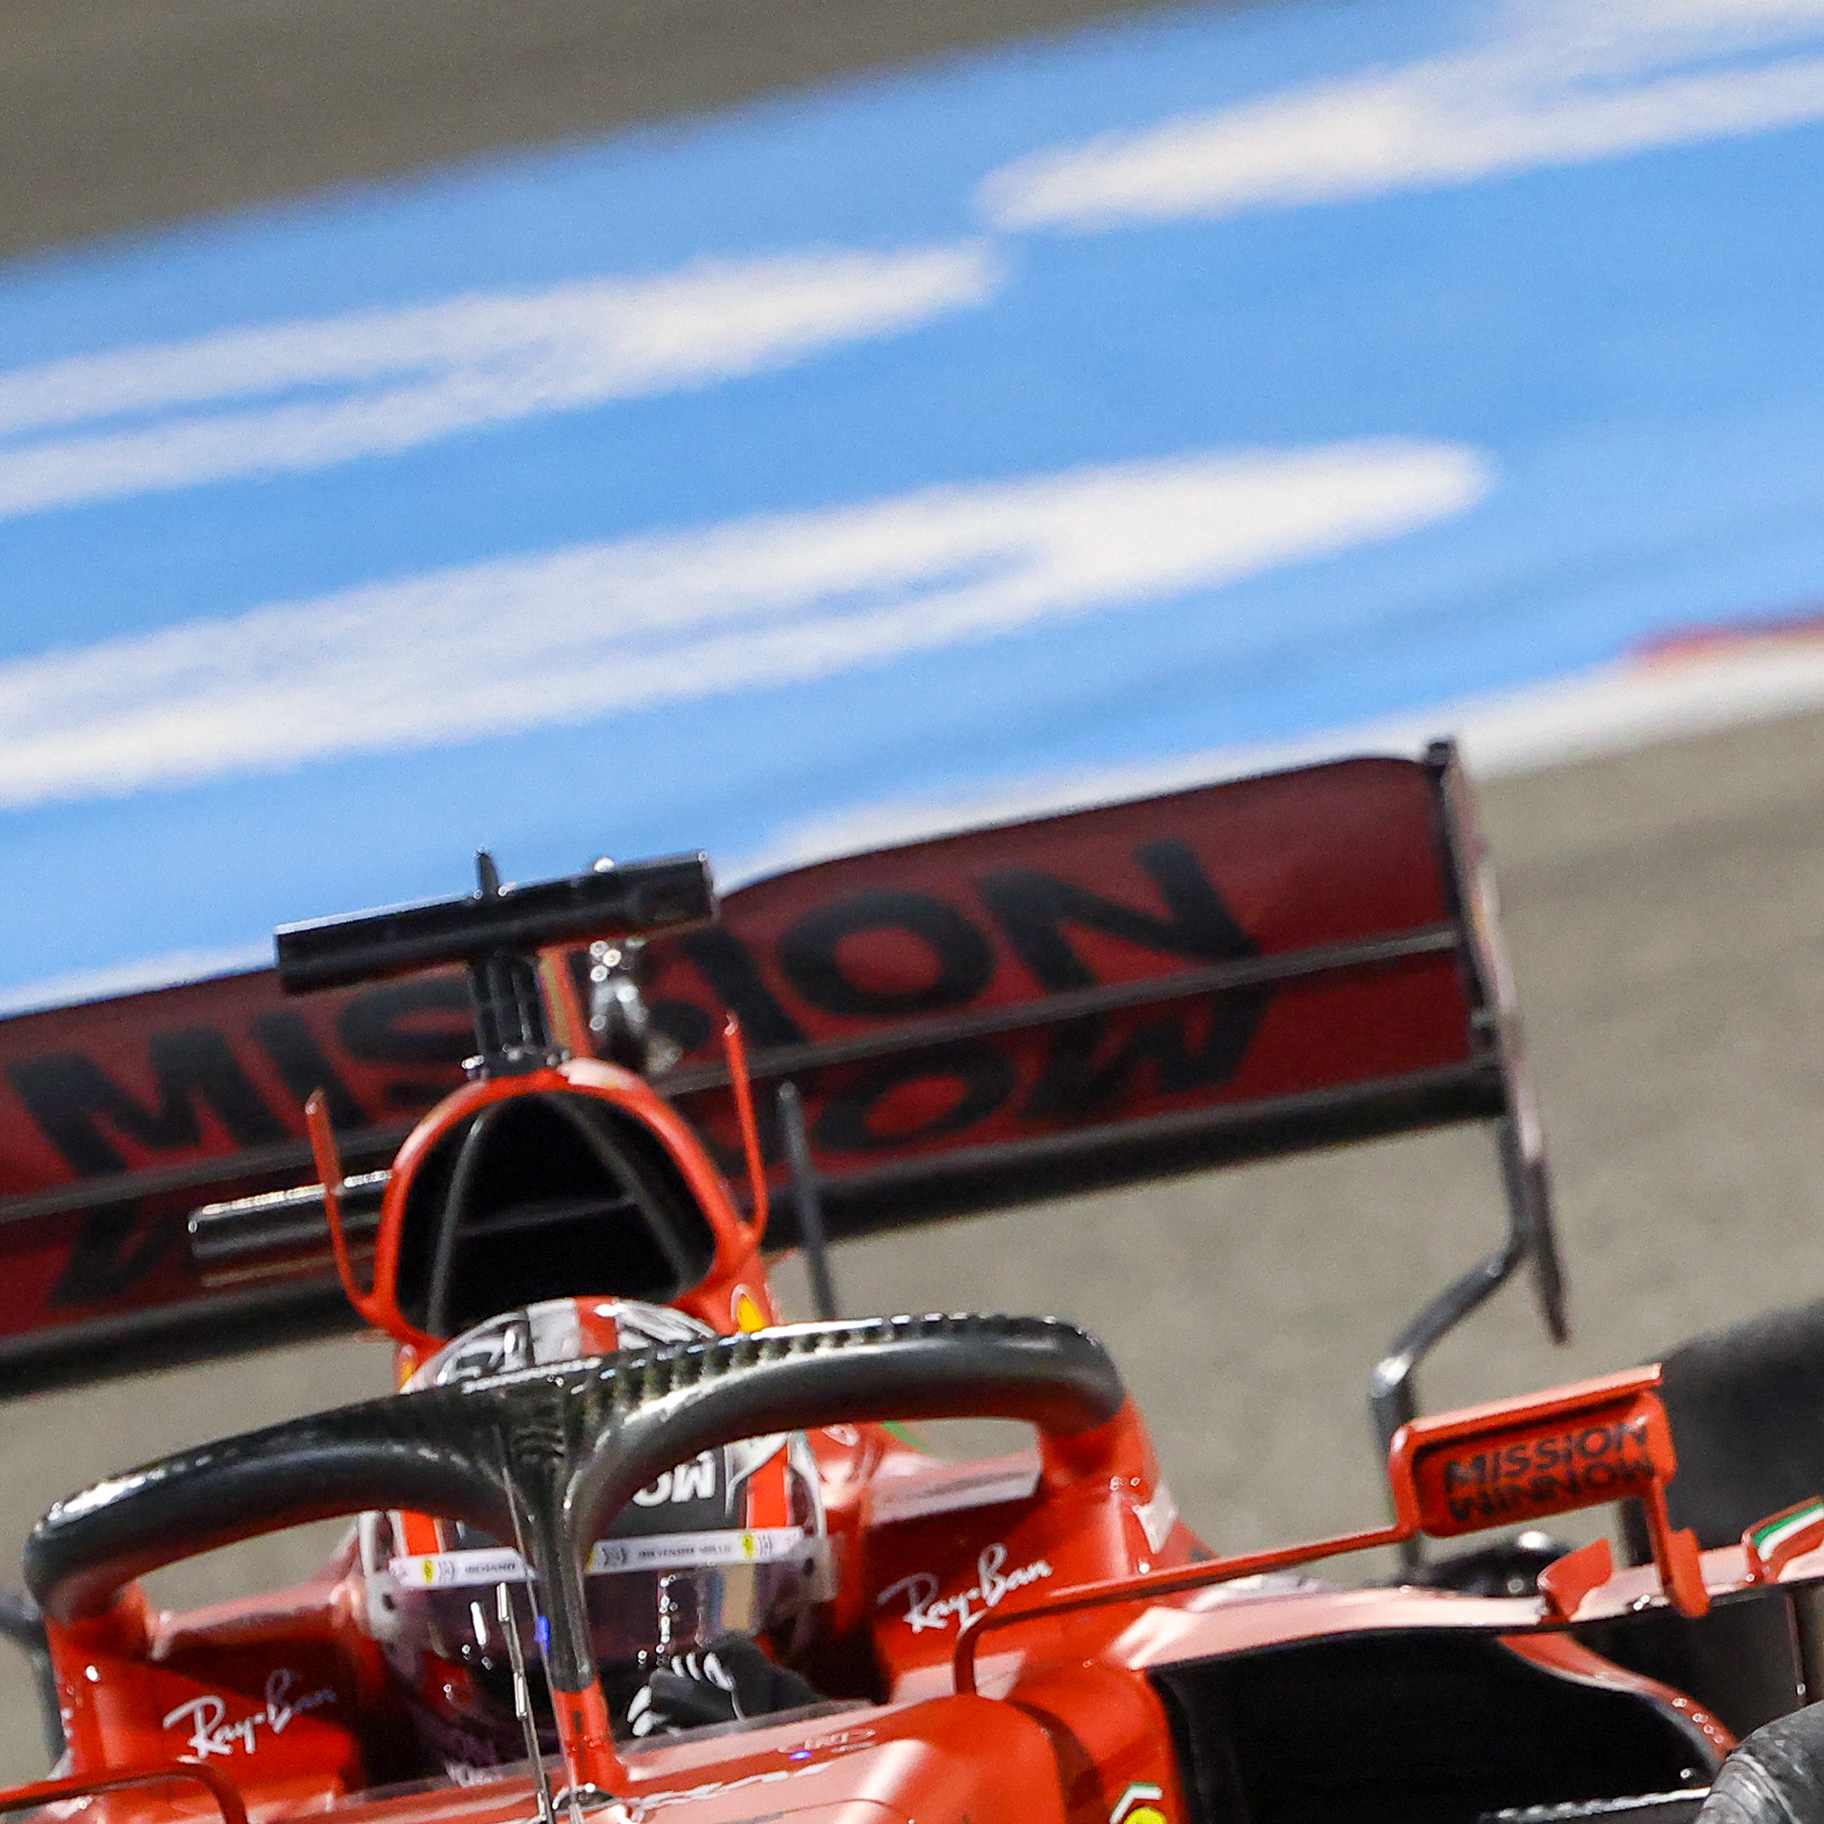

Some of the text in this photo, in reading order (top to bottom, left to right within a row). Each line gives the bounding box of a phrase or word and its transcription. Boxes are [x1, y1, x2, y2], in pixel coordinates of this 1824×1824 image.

[6, 837, 1264, 1174] MISION
[1443, 1422, 1649, 1494] MISSION
[878, 1542, 1053, 1640] Ray-Ban
